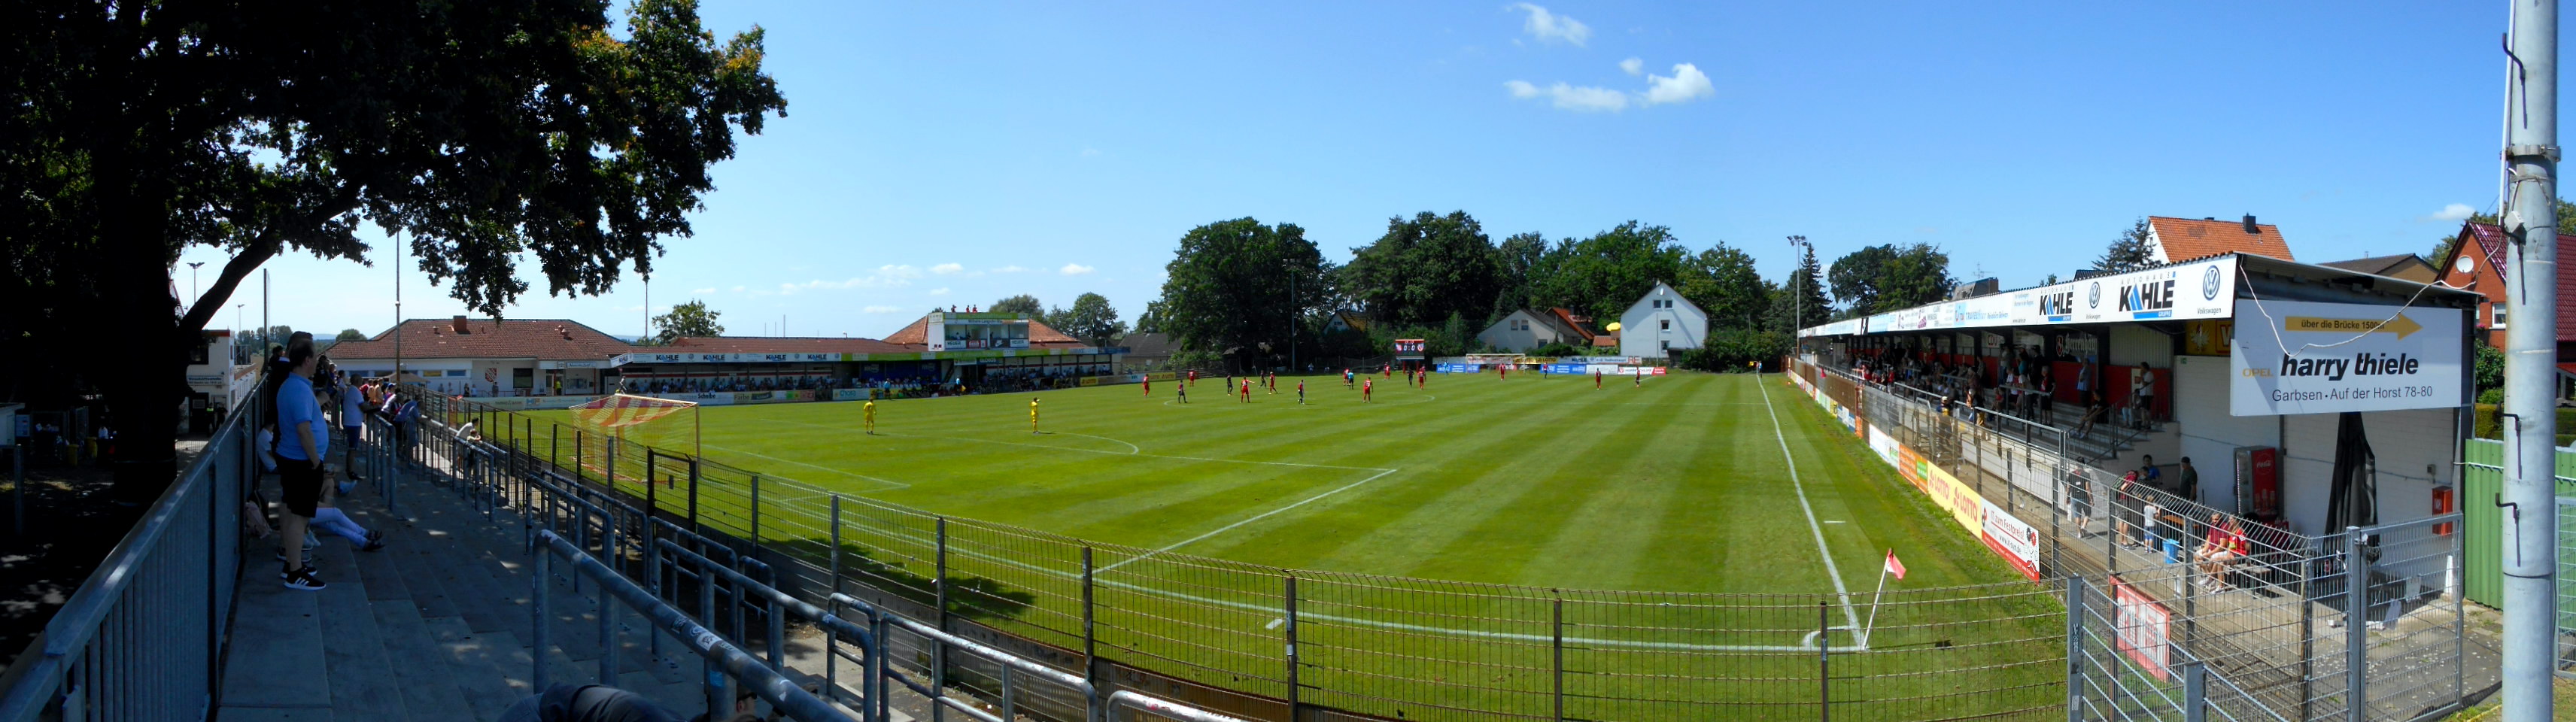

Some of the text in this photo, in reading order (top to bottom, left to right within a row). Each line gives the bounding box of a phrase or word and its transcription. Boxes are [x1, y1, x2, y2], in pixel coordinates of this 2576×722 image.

[2121, 272, 2170, 284] AUTOHAUS
[2301, 320, 2319, 328] über
[2321, 320, 2332, 329] die
[2334, 320, 2360, 329] Brücke
[2242, 353, 2419, 381] OPEL harry thiele
[2272, 386, 2432, 402] Garbsen Auf der Horst 78-80
[1935, 475, 1949, 499] LOTTO
[1960, 493, 1978, 523] LOTTO
[1995, 515, 2003, 526] zum
[2003, 519, 2025, 540] Festpreis!
